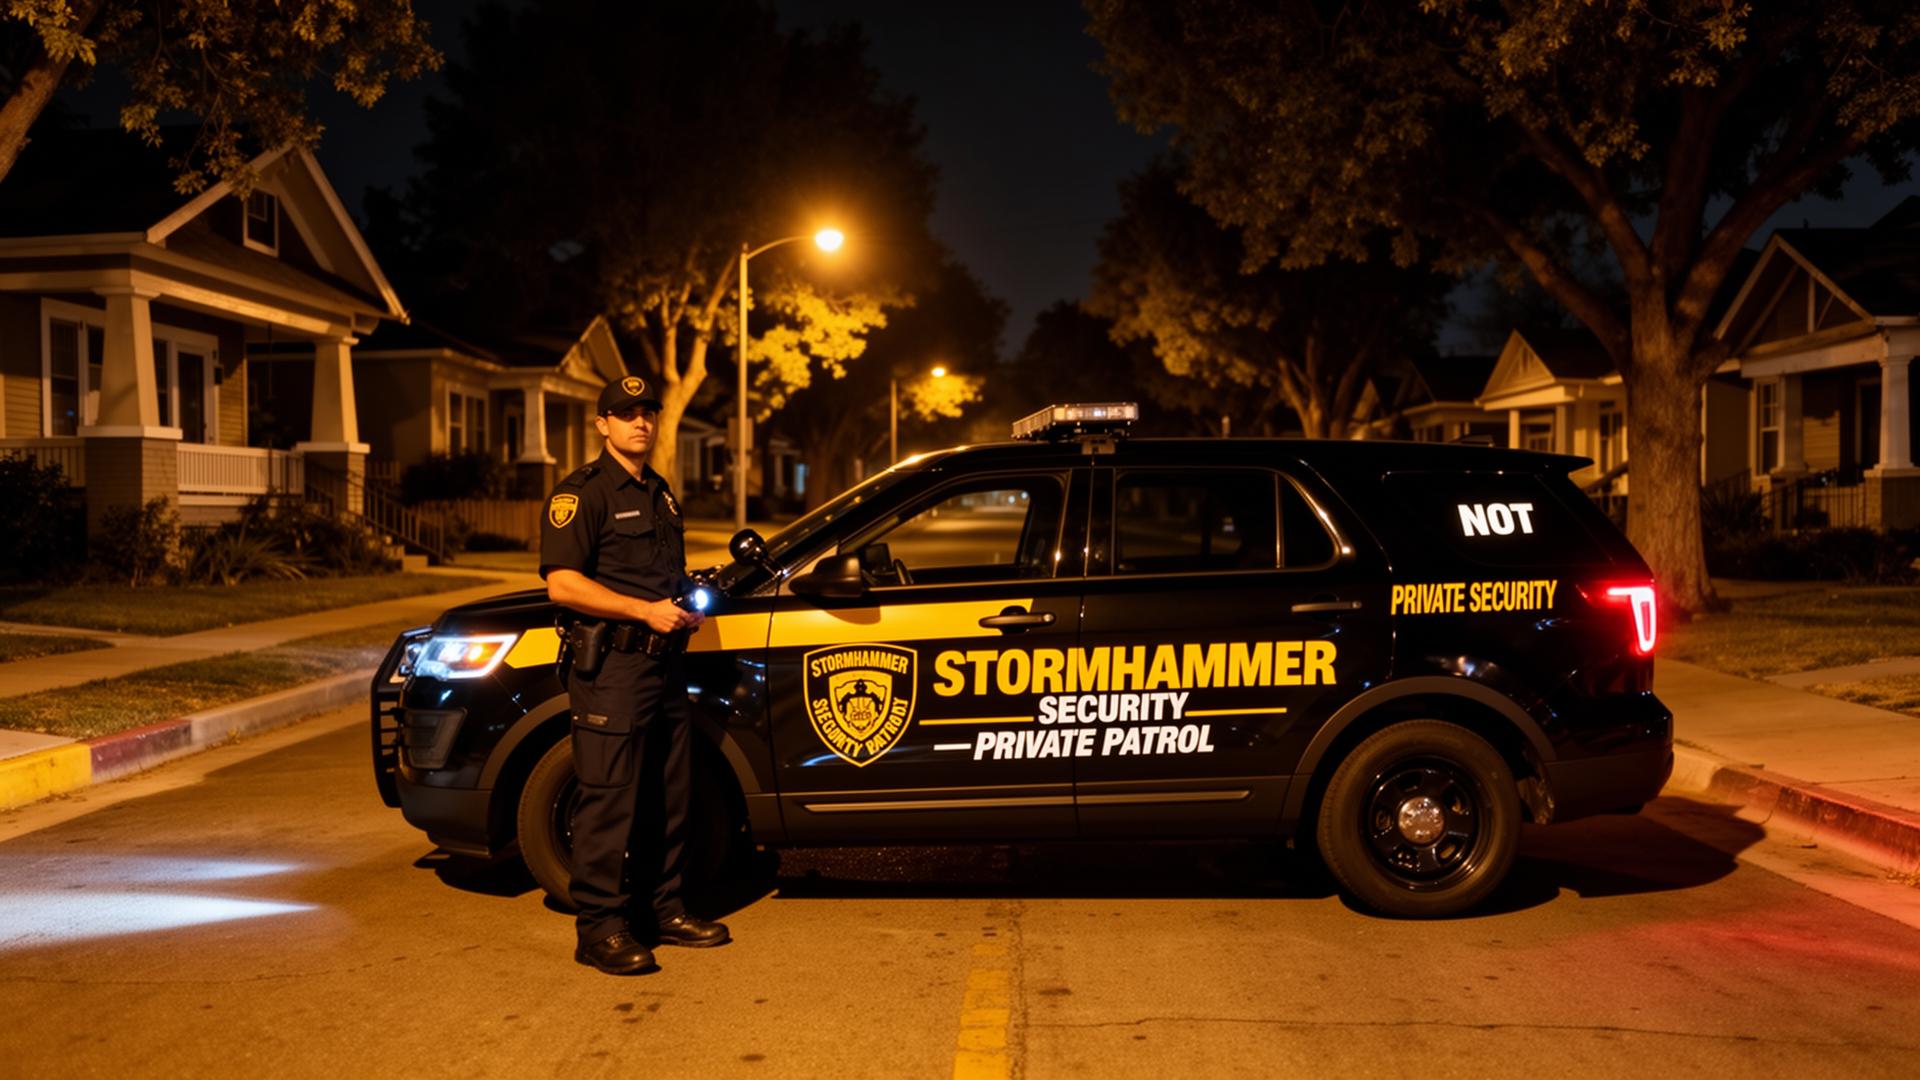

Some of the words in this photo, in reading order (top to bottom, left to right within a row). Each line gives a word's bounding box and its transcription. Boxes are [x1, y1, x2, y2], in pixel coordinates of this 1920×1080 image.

[1457, 503, 1534, 537] NOT
[1391, 583, 1466, 615] PRIVATE
[1469, 579, 1558, 612] SECURITY
[811, 650, 909, 678] STORMHAMMER
[933, 640, 1338, 696] STORMHAMMER
[1038, 692, 1190, 725] SECURITY
[973, 728, 1097, 760] PRIVATE
[1101, 724, 1215, 757] PATROL
